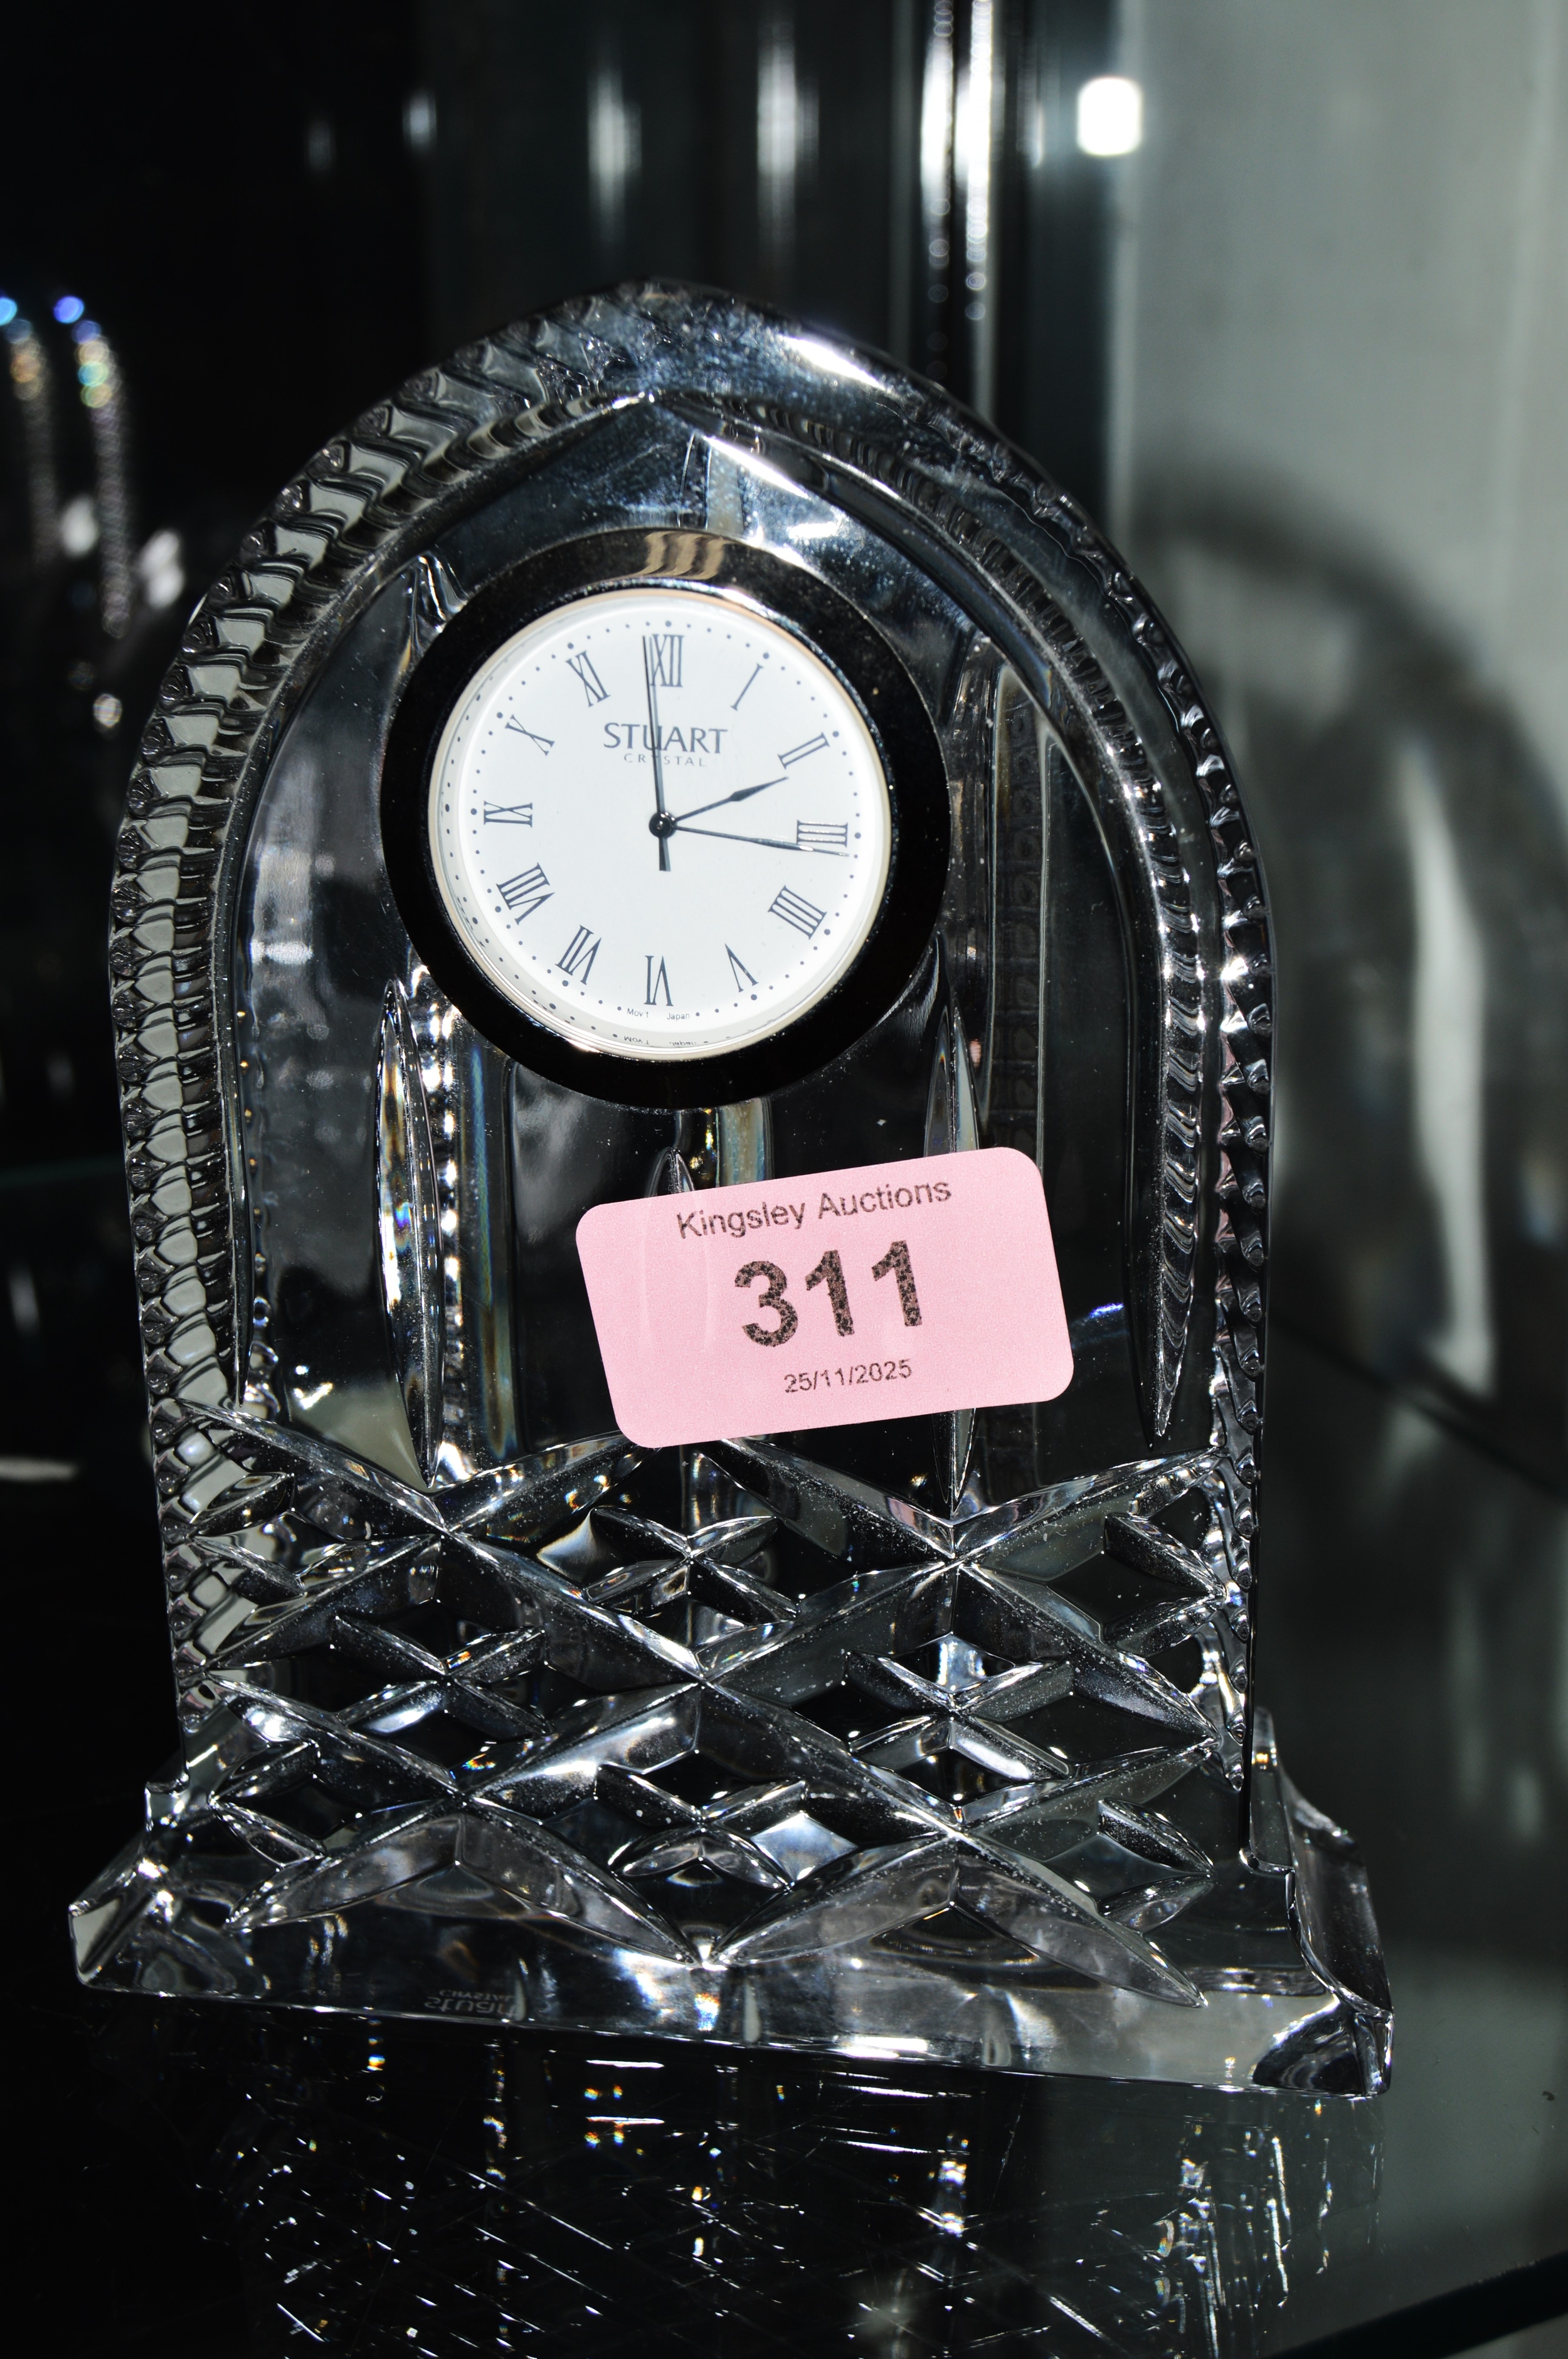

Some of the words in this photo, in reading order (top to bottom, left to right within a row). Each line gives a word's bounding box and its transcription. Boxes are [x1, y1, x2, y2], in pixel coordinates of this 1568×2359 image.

[566, 651, 611, 707] XI
[650, 634, 685, 688] XII
[505, 715, 555, 755] X
[603, 722, 728, 754] STUART
[777, 732, 830, 769] II
[484, 800, 533, 828] IX
[797, 819, 848, 848] III
[495, 862, 554, 925] VIII
[767, 885, 827, 940] IIII
[554, 925, 602, 985] VII
[724, 944, 759, 993] V
[644, 955, 674, 1007] VI
[666, 1012, 690, 1021] Japan
[677, 1203, 807, 1240] Kingsley
[818, 1179, 953, 1220] Auctions
[734, 1240, 923, 1348] 311
[783, 1358, 913, 1393] 25/11/2025
